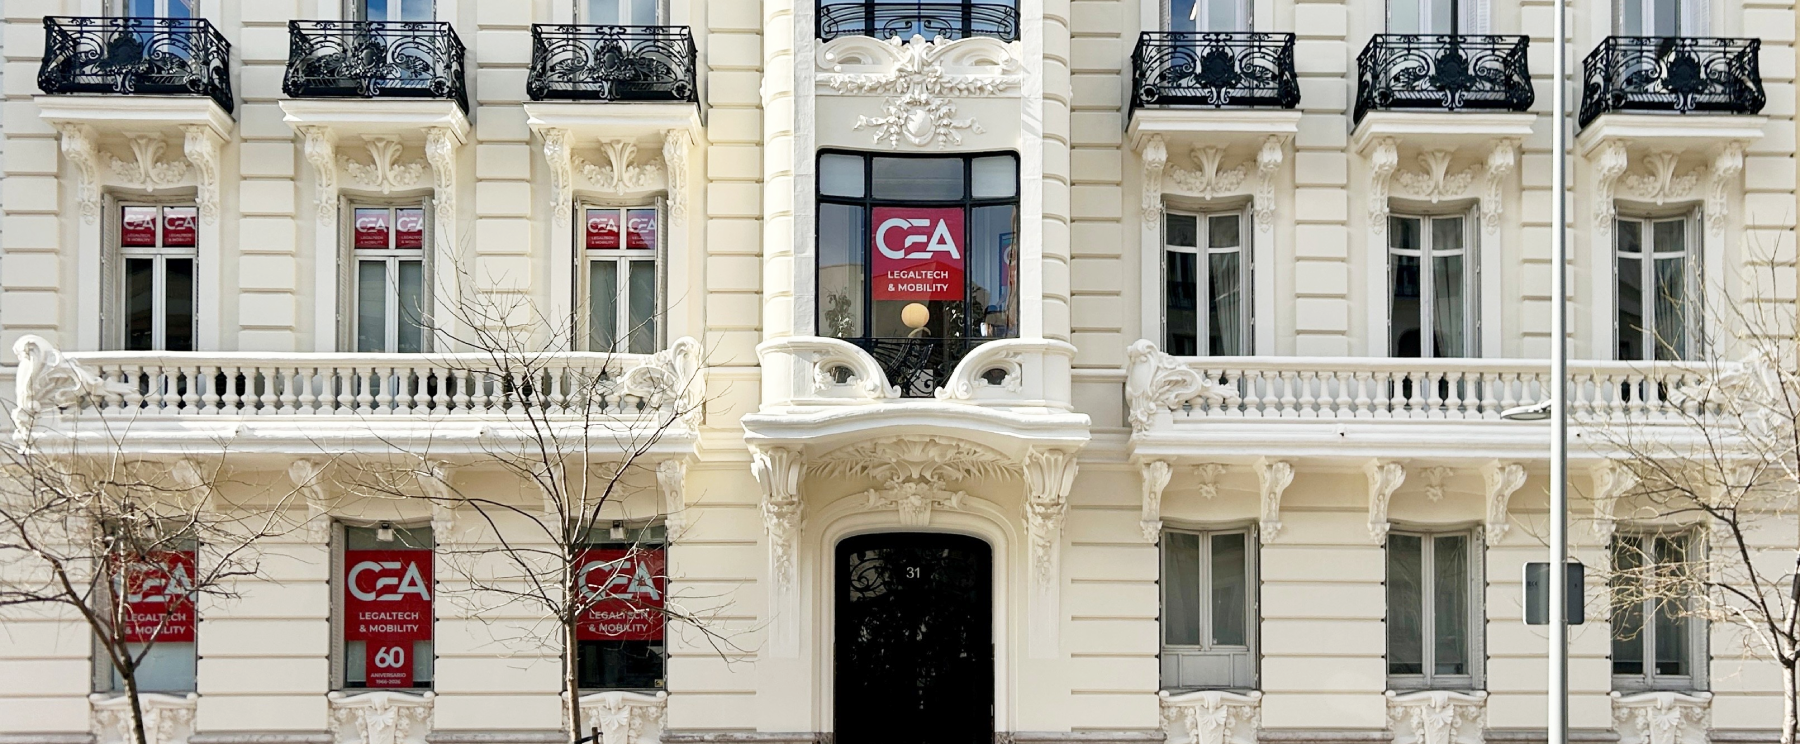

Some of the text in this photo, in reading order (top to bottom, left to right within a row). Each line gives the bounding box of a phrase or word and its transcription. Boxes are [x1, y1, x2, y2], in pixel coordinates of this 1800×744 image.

[164, 214, 196, 230] CEA
[356, 217, 388, 233] CEA
[588, 218, 619, 233] CEA
[876, 217, 961, 260] CEA
[887, 270, 949, 279] LEGALTECH
[887, 283, 949, 292] & MOBILITY
[906, 566, 920, 579] 31
[347, 561, 431, 602] CEA
[578, 560, 661, 601] CEA
[125, 613, 186, 621] LEGALTCH
[359, 612, 419, 620] LEGALTECH
[125, 626, 133, 634] &
[359, 624, 419, 633] & MOBILITY
[588, 624, 649, 633] & MOBILITY
[374, 646, 405, 669] 60
